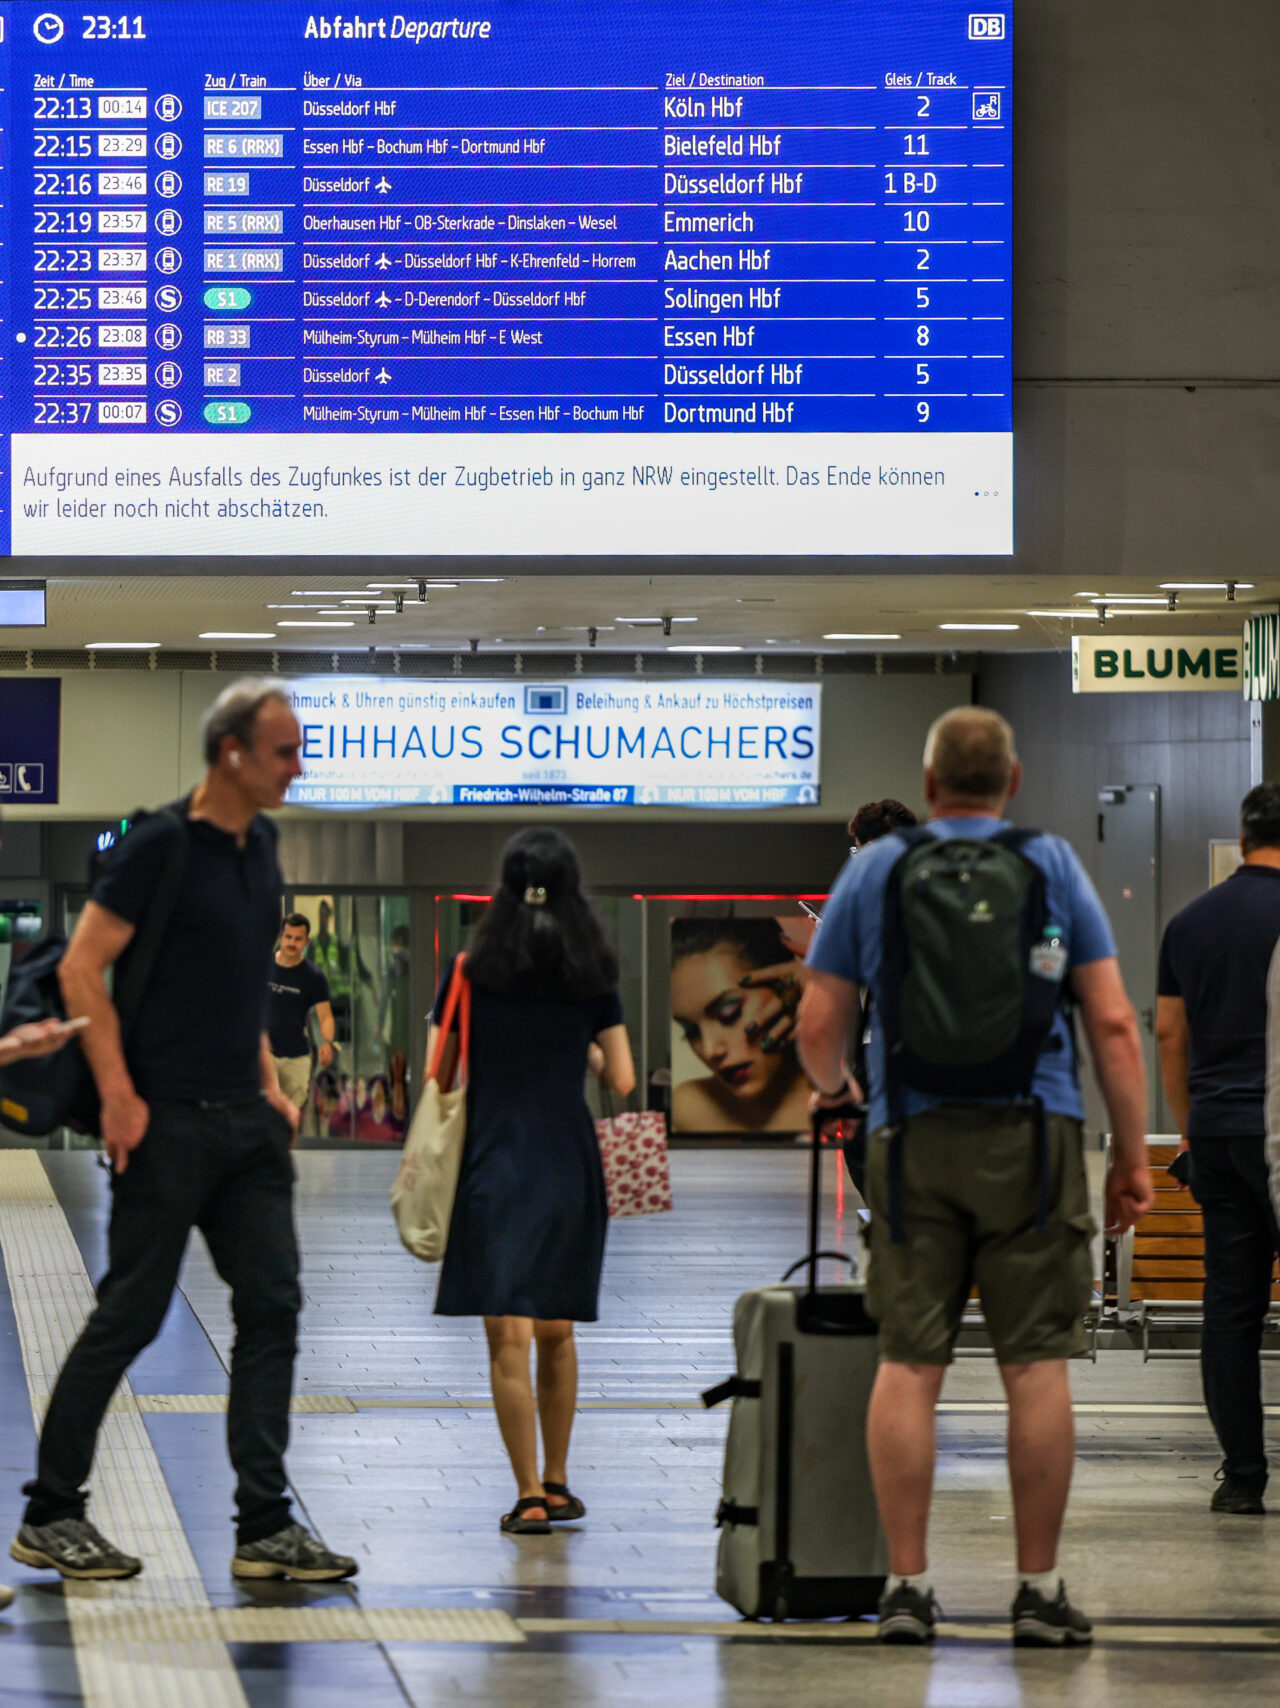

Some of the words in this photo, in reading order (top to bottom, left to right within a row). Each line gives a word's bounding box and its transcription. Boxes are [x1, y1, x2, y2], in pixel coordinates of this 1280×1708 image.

[82, 15, 147, 40] 23:11
[303, 15, 387, 39] Abfahrt
[390, 14, 492, 45] Departure
[973, 17, 1001, 36] DB
[33, 73, 56, 88] Zeit
[68, 73, 95, 88] Time
[303, 71, 331, 88] Über
[343, 73, 363, 88] Via
[665, 72, 686, 87] Ziel
[699, 72, 765, 87] Destination
[884, 72, 913, 87] Gleis
[926, 71, 957, 86] Track
[33, 96, 92, 119] 22:13
[103, 99, 142, 114] 00:14
[207, 100, 228, 116] ICE
[231, 100, 258, 116] 207
[303, 100, 371, 116] Düsseldorf
[374, 100, 397, 116] Hbf
[664, 96, 705, 118] Köln
[711, 96, 744, 118] Hbf
[917, 95, 930, 118] 2
[33, 173, 92, 196] 22:16
[103, 176, 143, 190] 23:46
[207, 177, 224, 193] RE
[228, 177, 246, 193] 19
[303, 176, 371, 193] Düsseldorf
[664, 172, 765, 195] Düsseldorf
[771, 172, 803, 194] Hbf
[884, 172, 898, 194] 1
[903, 172, 937, 194] B-D
[33, 364, 92, 386] 22:35
[103, 366, 143, 381] 23:35
[207, 368, 224, 383] RE
[228, 368, 237, 383] 2
[303, 367, 371, 383] Düsseldorf
[664, 363, 765, 385] Düsseldorf
[771, 363, 803, 385] Hbf
[916, 363, 930, 385] 5
[23, 466, 108, 492] Aufgrund
[115, 468, 161, 487] eines
[168, 465, 243, 487] Ausfalls
[250, 466, 281, 487] des
[288, 465, 382, 492] Zugfunkes
[389, 467, 411, 487] ist
[418, 466, 447, 487] der
[455, 465, 554, 492] Zugbetrieb
[560, 467, 575, 486] in
[582, 471, 625, 492] ganz
[632, 465, 673, 486] NRW
[680, 465, 779, 491] eingestellt.
[786, 465, 820, 486] Das
[827, 465, 872, 486] Ende
[878, 465, 945, 486] können
[23, 499, 50, 518] wir
[57, 497, 107, 518] leider
[114, 497, 158, 518] noch
[165, 497, 210, 518] nicht
[217, 497, 328, 518] abschätzen.
[1093, 647, 1239, 679] BLUME
[287, 691, 337, 709] chmuck
[341, 692, 351, 709] &
[355, 691, 394, 709] Uhren
[399, 693, 446, 713] günstig
[450, 691, 516, 710] einkaufen
[576, 691, 639, 713] Beleihung
[643, 692, 652, 710] &
[657, 692, 702, 710] Ankauf
[705, 697, 719, 710] zu
[723, 692, 814, 713] Höchstpreisen
[302, 724, 484, 759] EIHHAUS
[499, 724, 815, 760] SCHUMACHERS
[459, 787, 611, 803] Friedrich-Wilhelm-Straße
[612, 788, 629, 803] 87
